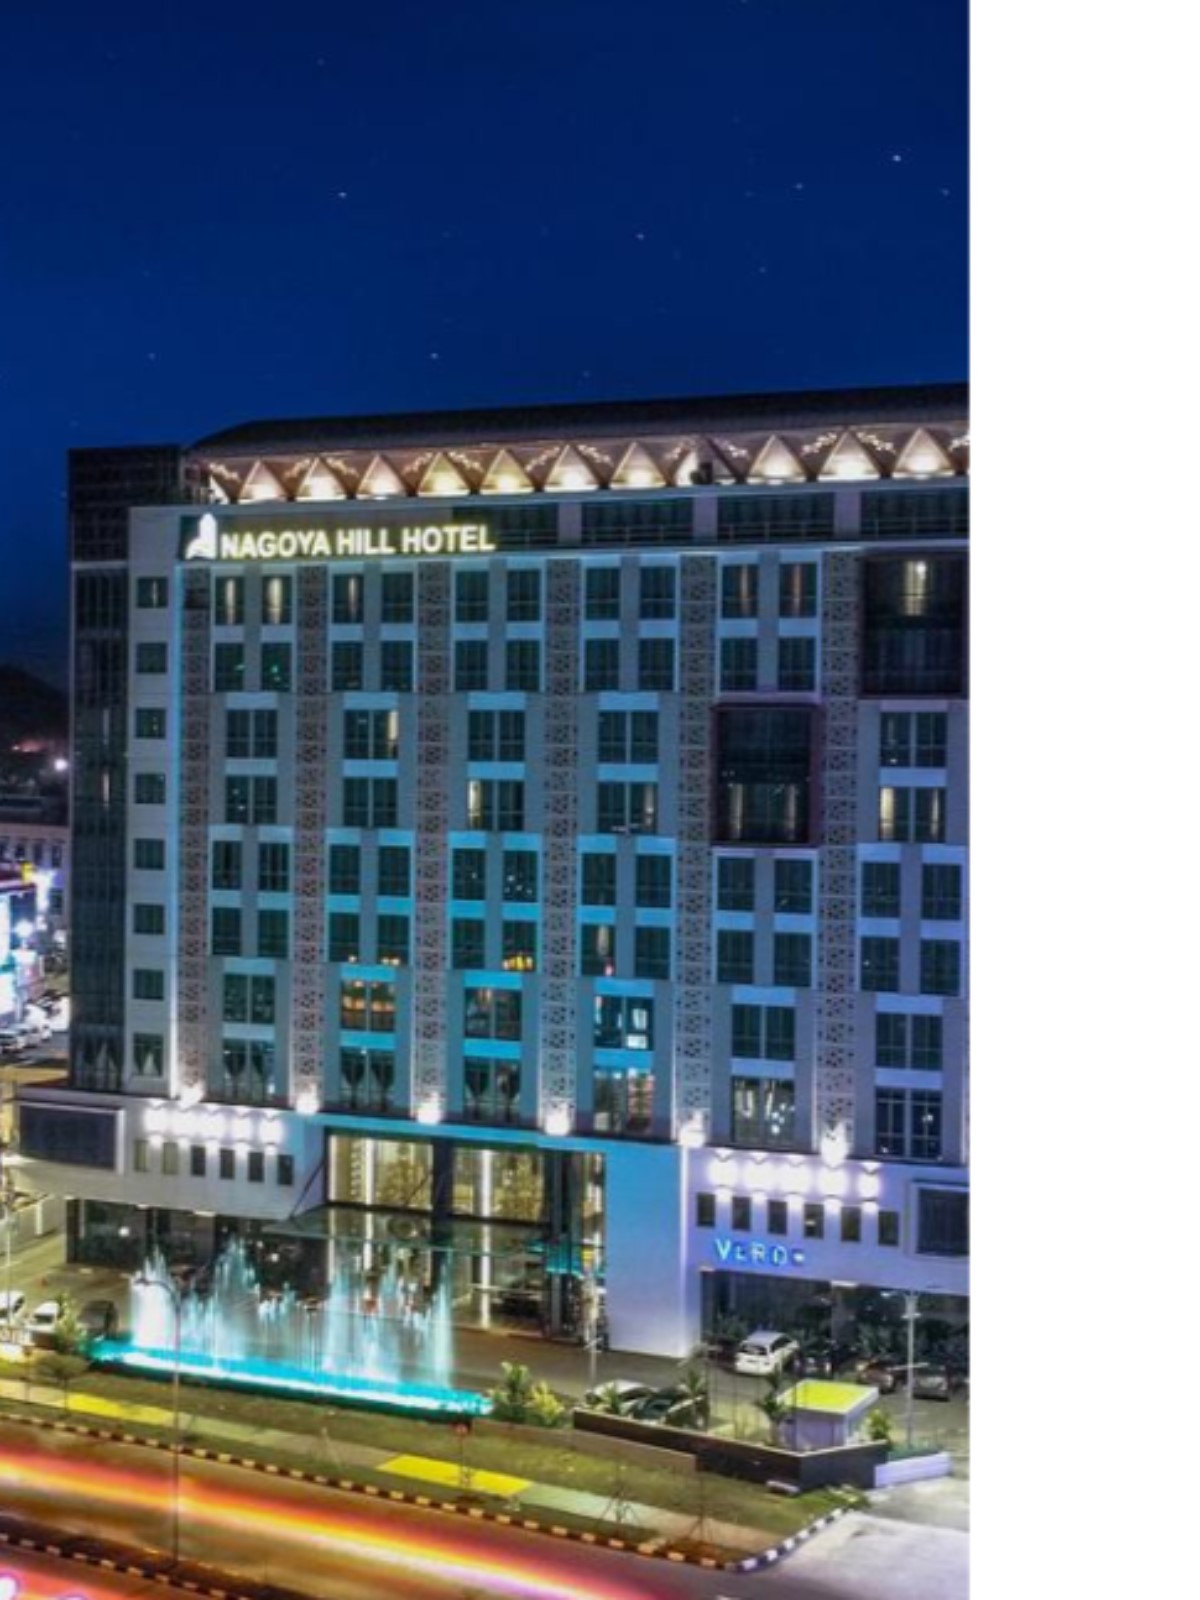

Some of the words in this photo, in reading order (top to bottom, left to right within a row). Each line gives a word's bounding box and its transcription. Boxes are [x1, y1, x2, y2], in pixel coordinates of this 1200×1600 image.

[220, 529, 330, 559] NAGOYA
[336, 526, 396, 555] HILL
[401, 524, 496, 554] HOTEL
